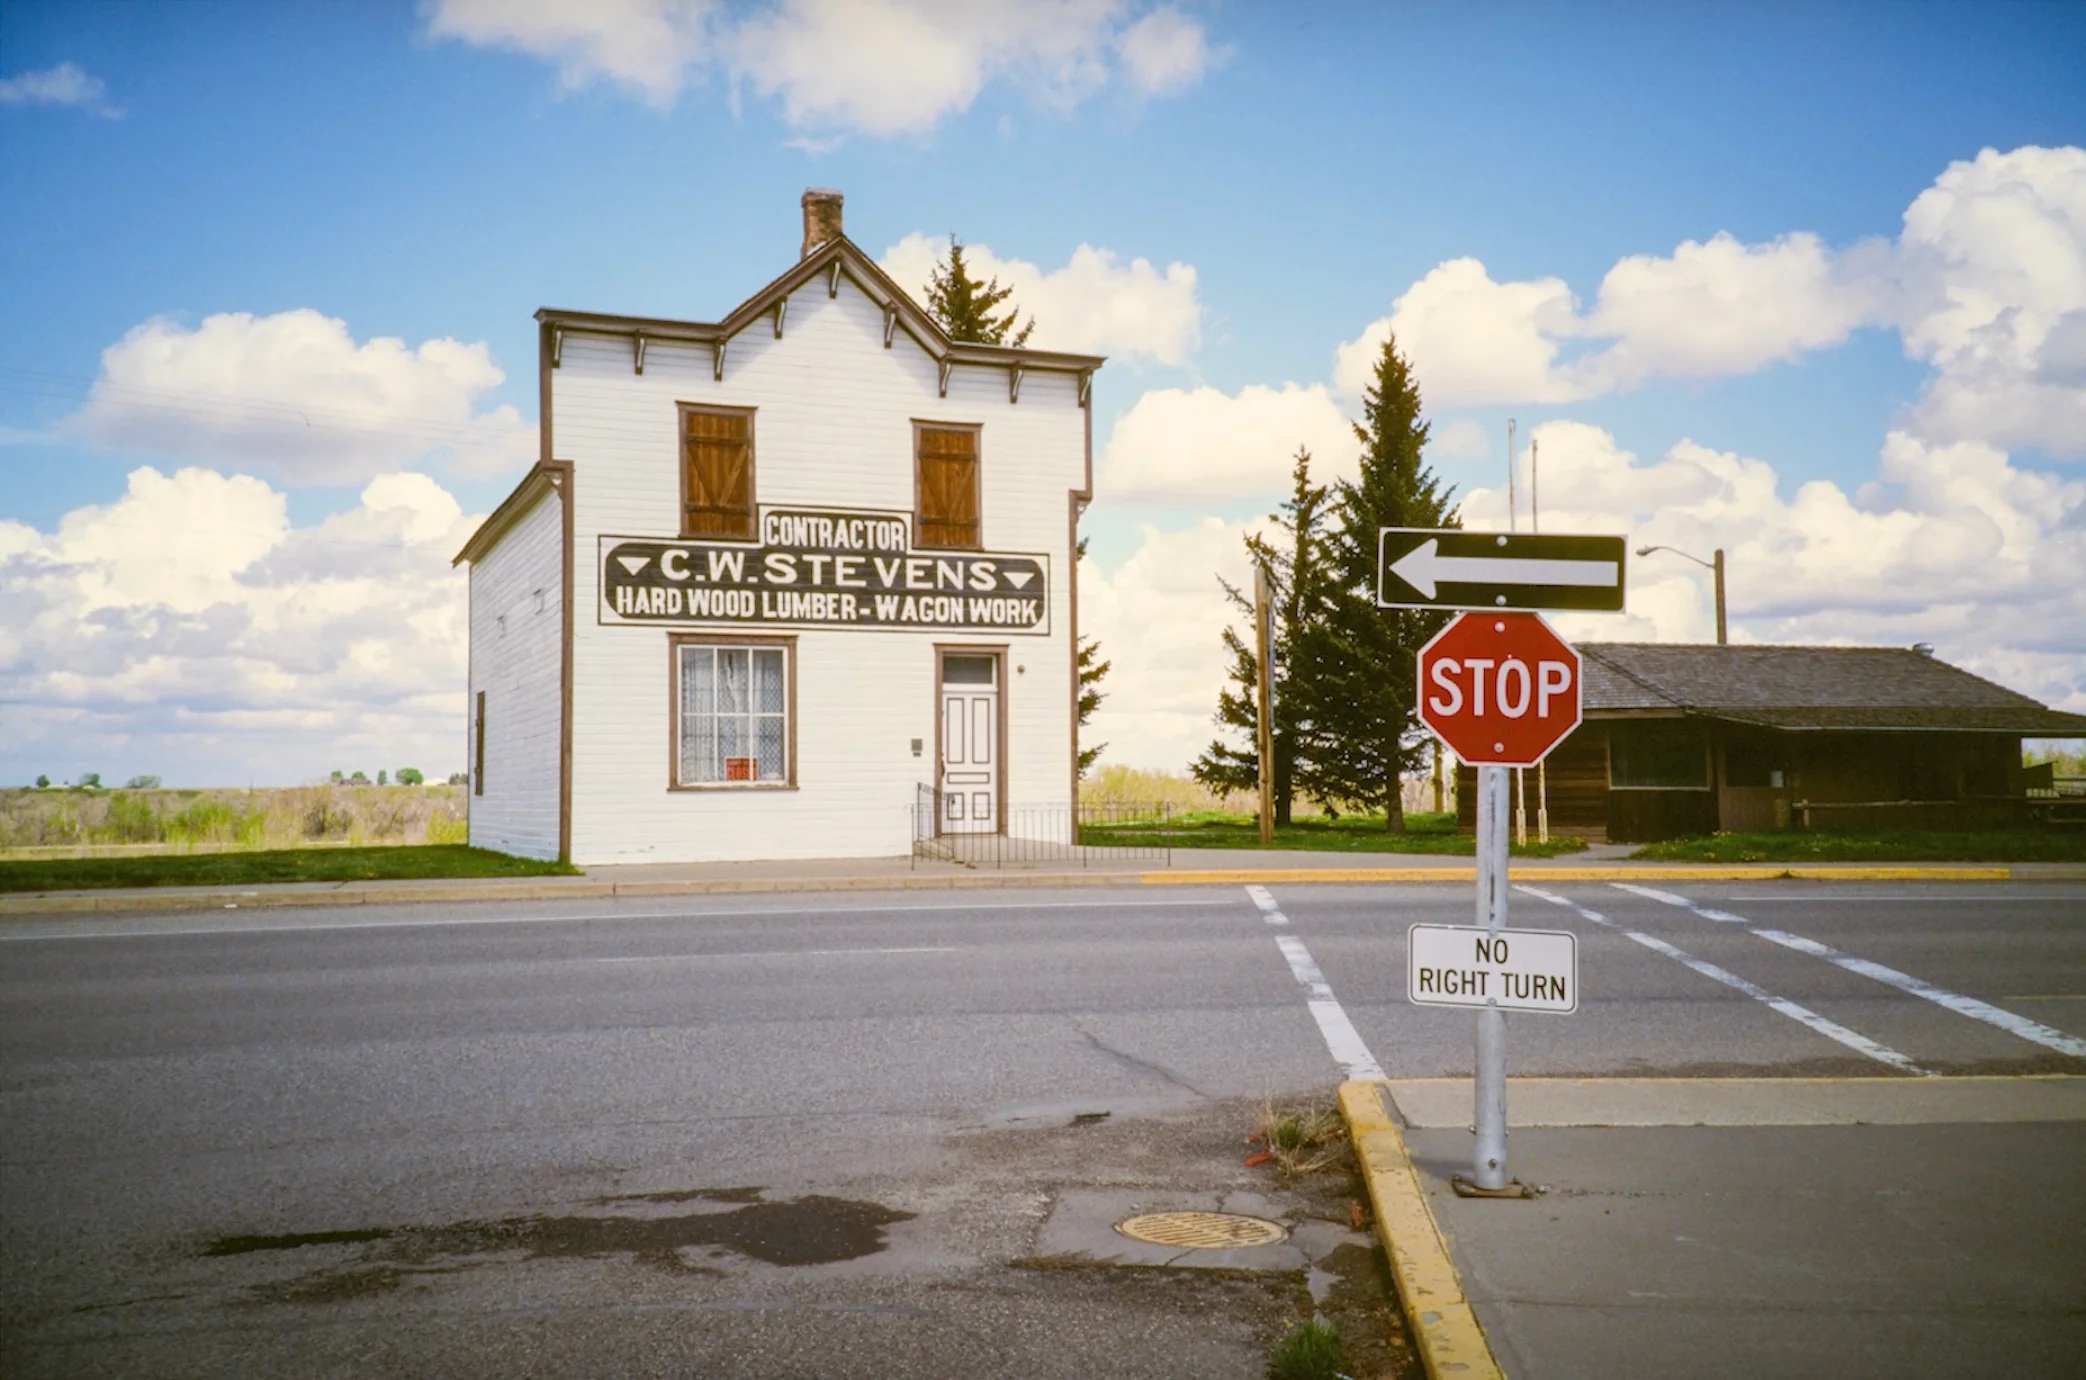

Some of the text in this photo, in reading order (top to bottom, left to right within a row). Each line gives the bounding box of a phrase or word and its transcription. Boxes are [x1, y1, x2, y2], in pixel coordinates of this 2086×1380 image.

[765, 515, 905, 551] CONTRACTOR
[616, 585, 682, 615] HARD
[687, 588, 755, 617] WOOD
[969, 598, 1038, 624] WORK
[1429, 657, 1572, 718] STOP
[1475, 938, 1509, 964] NO
[1419, 967, 1566, 1001] RIGHT TURN
